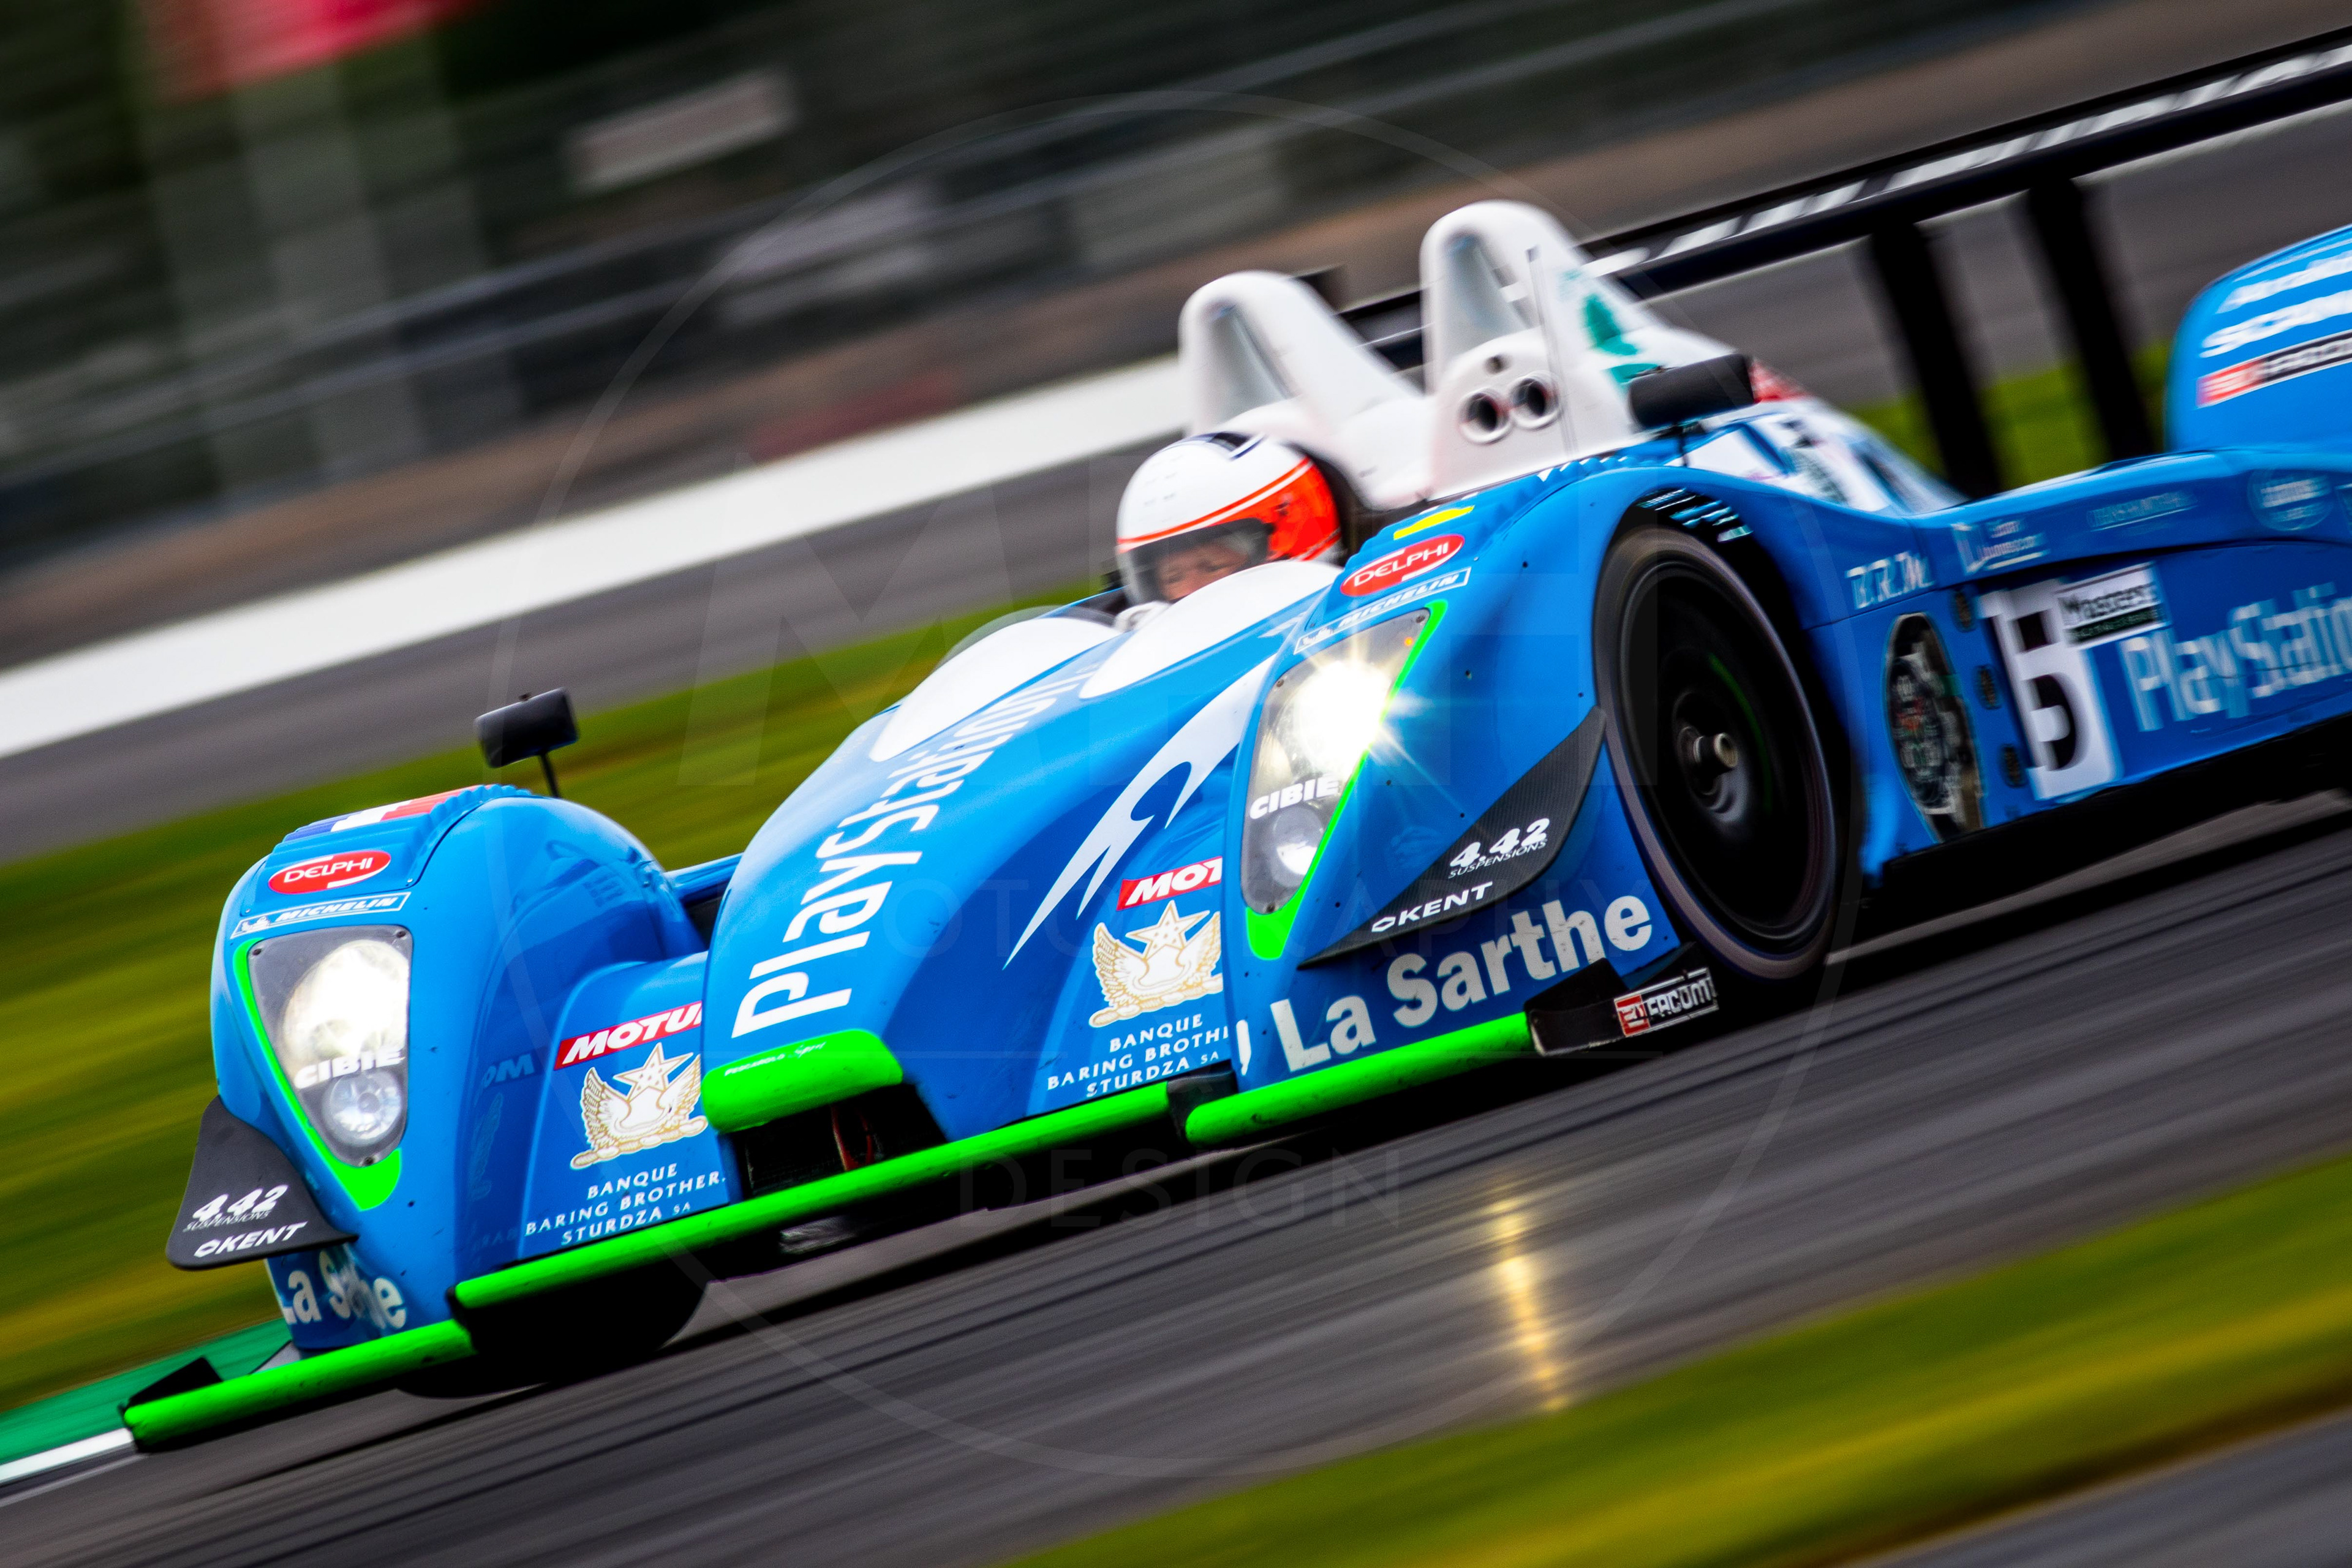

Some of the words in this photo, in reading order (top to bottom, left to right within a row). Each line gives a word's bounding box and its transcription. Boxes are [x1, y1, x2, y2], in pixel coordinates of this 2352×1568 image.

[1353, 541, 1449, 587] DELPHI
[1339, 574, 1457, 628] MICHELIN
[1249, 773, 1339, 820] CIBIE
[283, 858, 372, 884] DELPHI
[731, 671, 1095, 1038] PlayStation
[1448, 837, 1549, 878] SUSPENSIONS
[275, 896, 399, 922] MICHELIN
[1270, 995, 1376, 1072] La
[1387, 895, 1653, 1028] Sarthe
[1109, 1014, 1204, 1053] BANQUE
[294, 1047, 402, 1089] CIBIE
[1047, 1054, 1133, 1091] BARING
[1087, 1057, 1190, 1098] STURDZA
[1200, 1051, 1219, 1065] SA
[587, 1163, 678, 1200] BANQUE
[184, 1210, 271, 1233] SUSPENSIONS
[524, 1202, 609, 1237] BARING
[619, 1170, 726, 1212] BROTHER
[561, 1206, 662, 1246] STURDZA
[673, 1201, 692, 1216] SA
